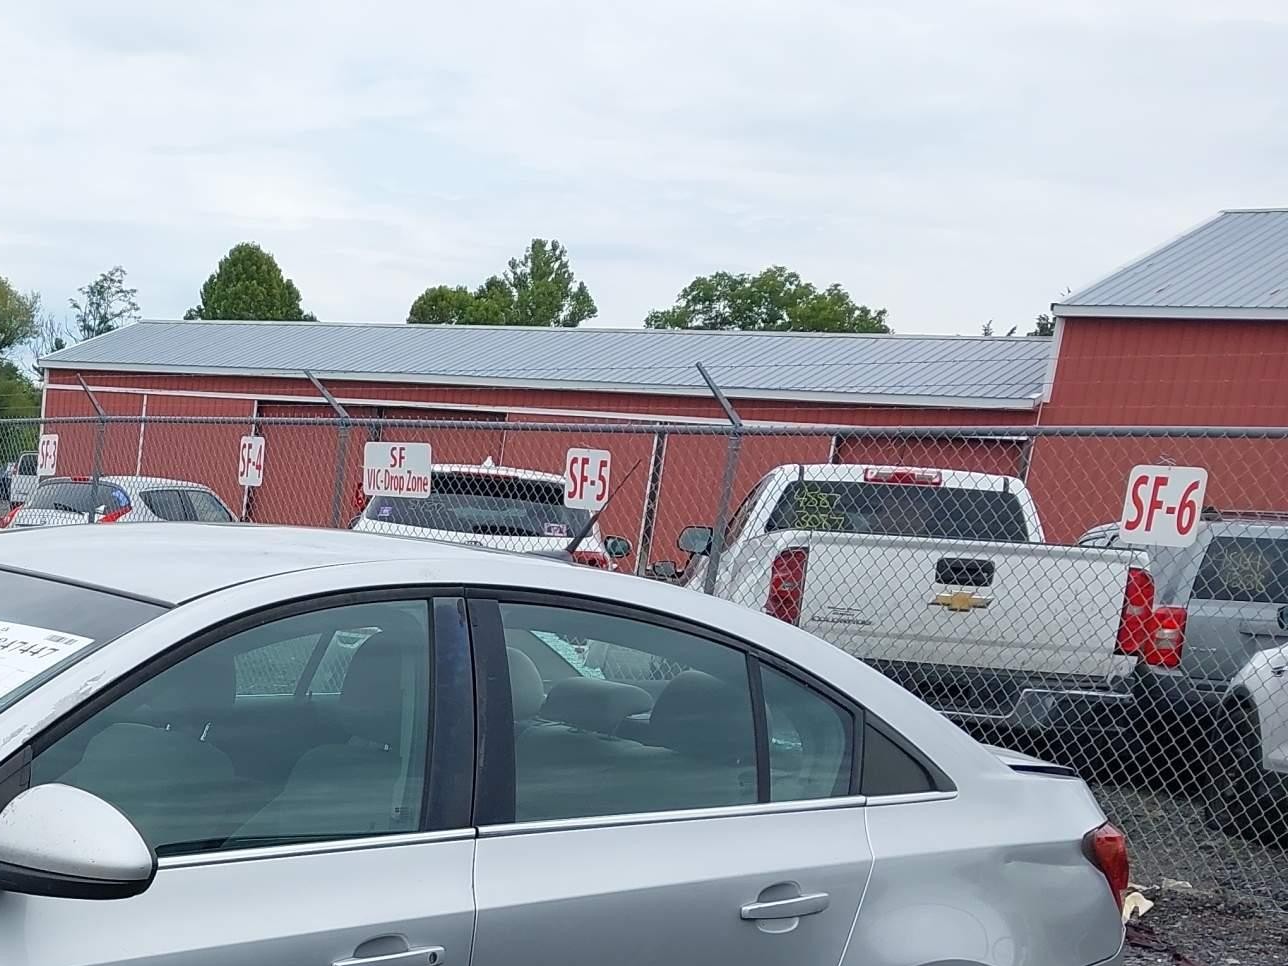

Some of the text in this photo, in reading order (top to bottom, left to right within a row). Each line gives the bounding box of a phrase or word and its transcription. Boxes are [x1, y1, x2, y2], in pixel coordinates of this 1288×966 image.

[39, 440, 56, 469] SF-3
[240, 443, 263, 478] SF-4
[390, 446, 406, 468] SF
[367, 469, 428, 495] VIC-Drop Zone
[568, 457, 608, 502] SF-5
[794, 487, 841, 509] 4587
[1124, 475, 1200, 536] SF-6
